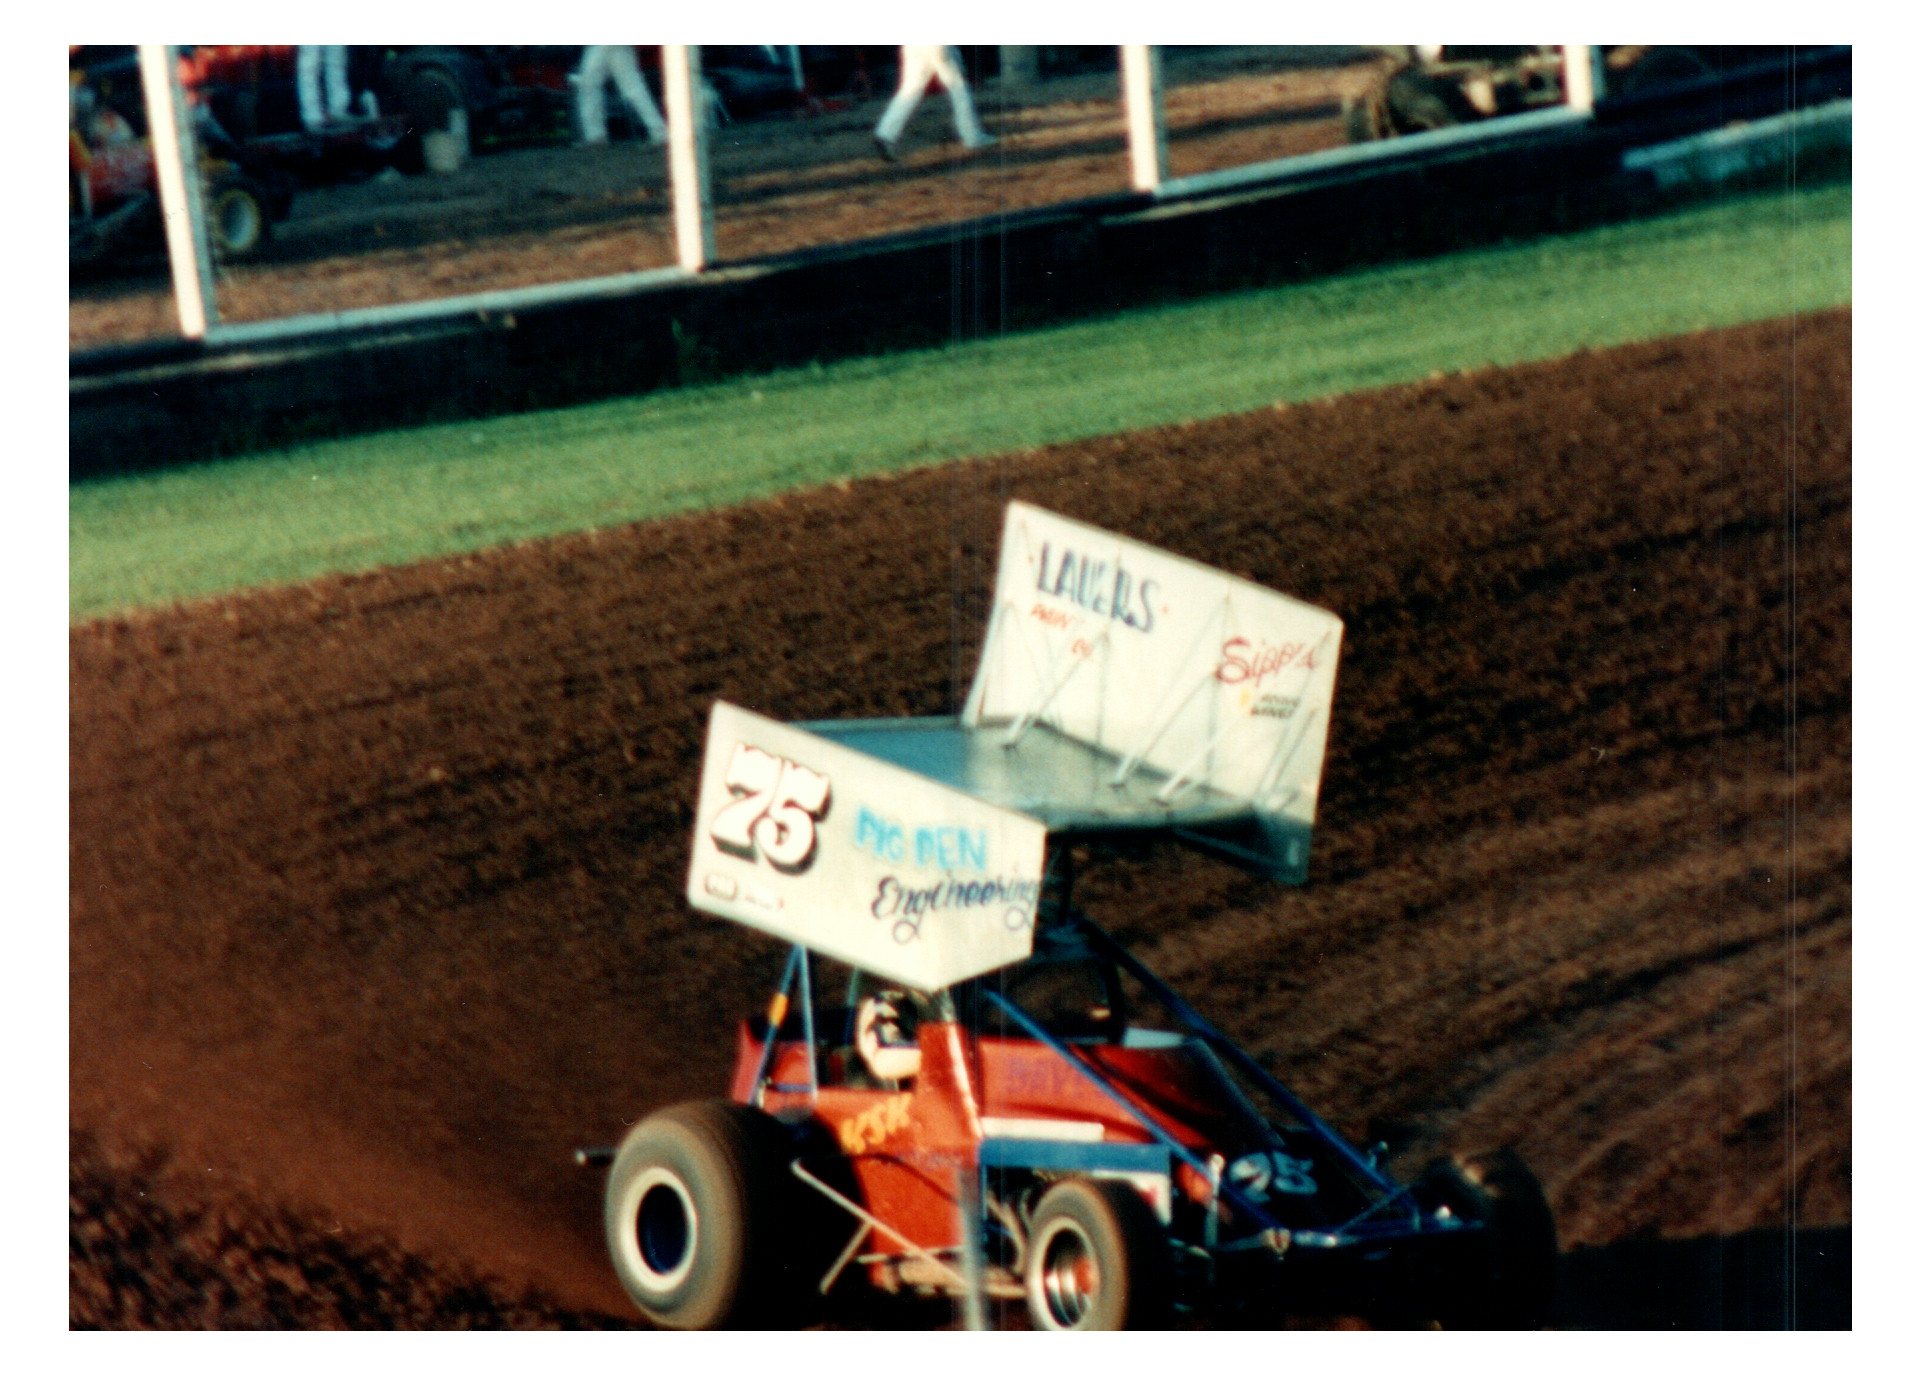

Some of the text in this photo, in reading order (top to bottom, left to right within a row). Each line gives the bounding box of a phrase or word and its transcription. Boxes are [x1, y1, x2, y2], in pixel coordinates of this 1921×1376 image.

[710, 742, 834, 876] 75
[914, 826, 987, 872] PEN
[871, 866, 1039, 944] Engineering
